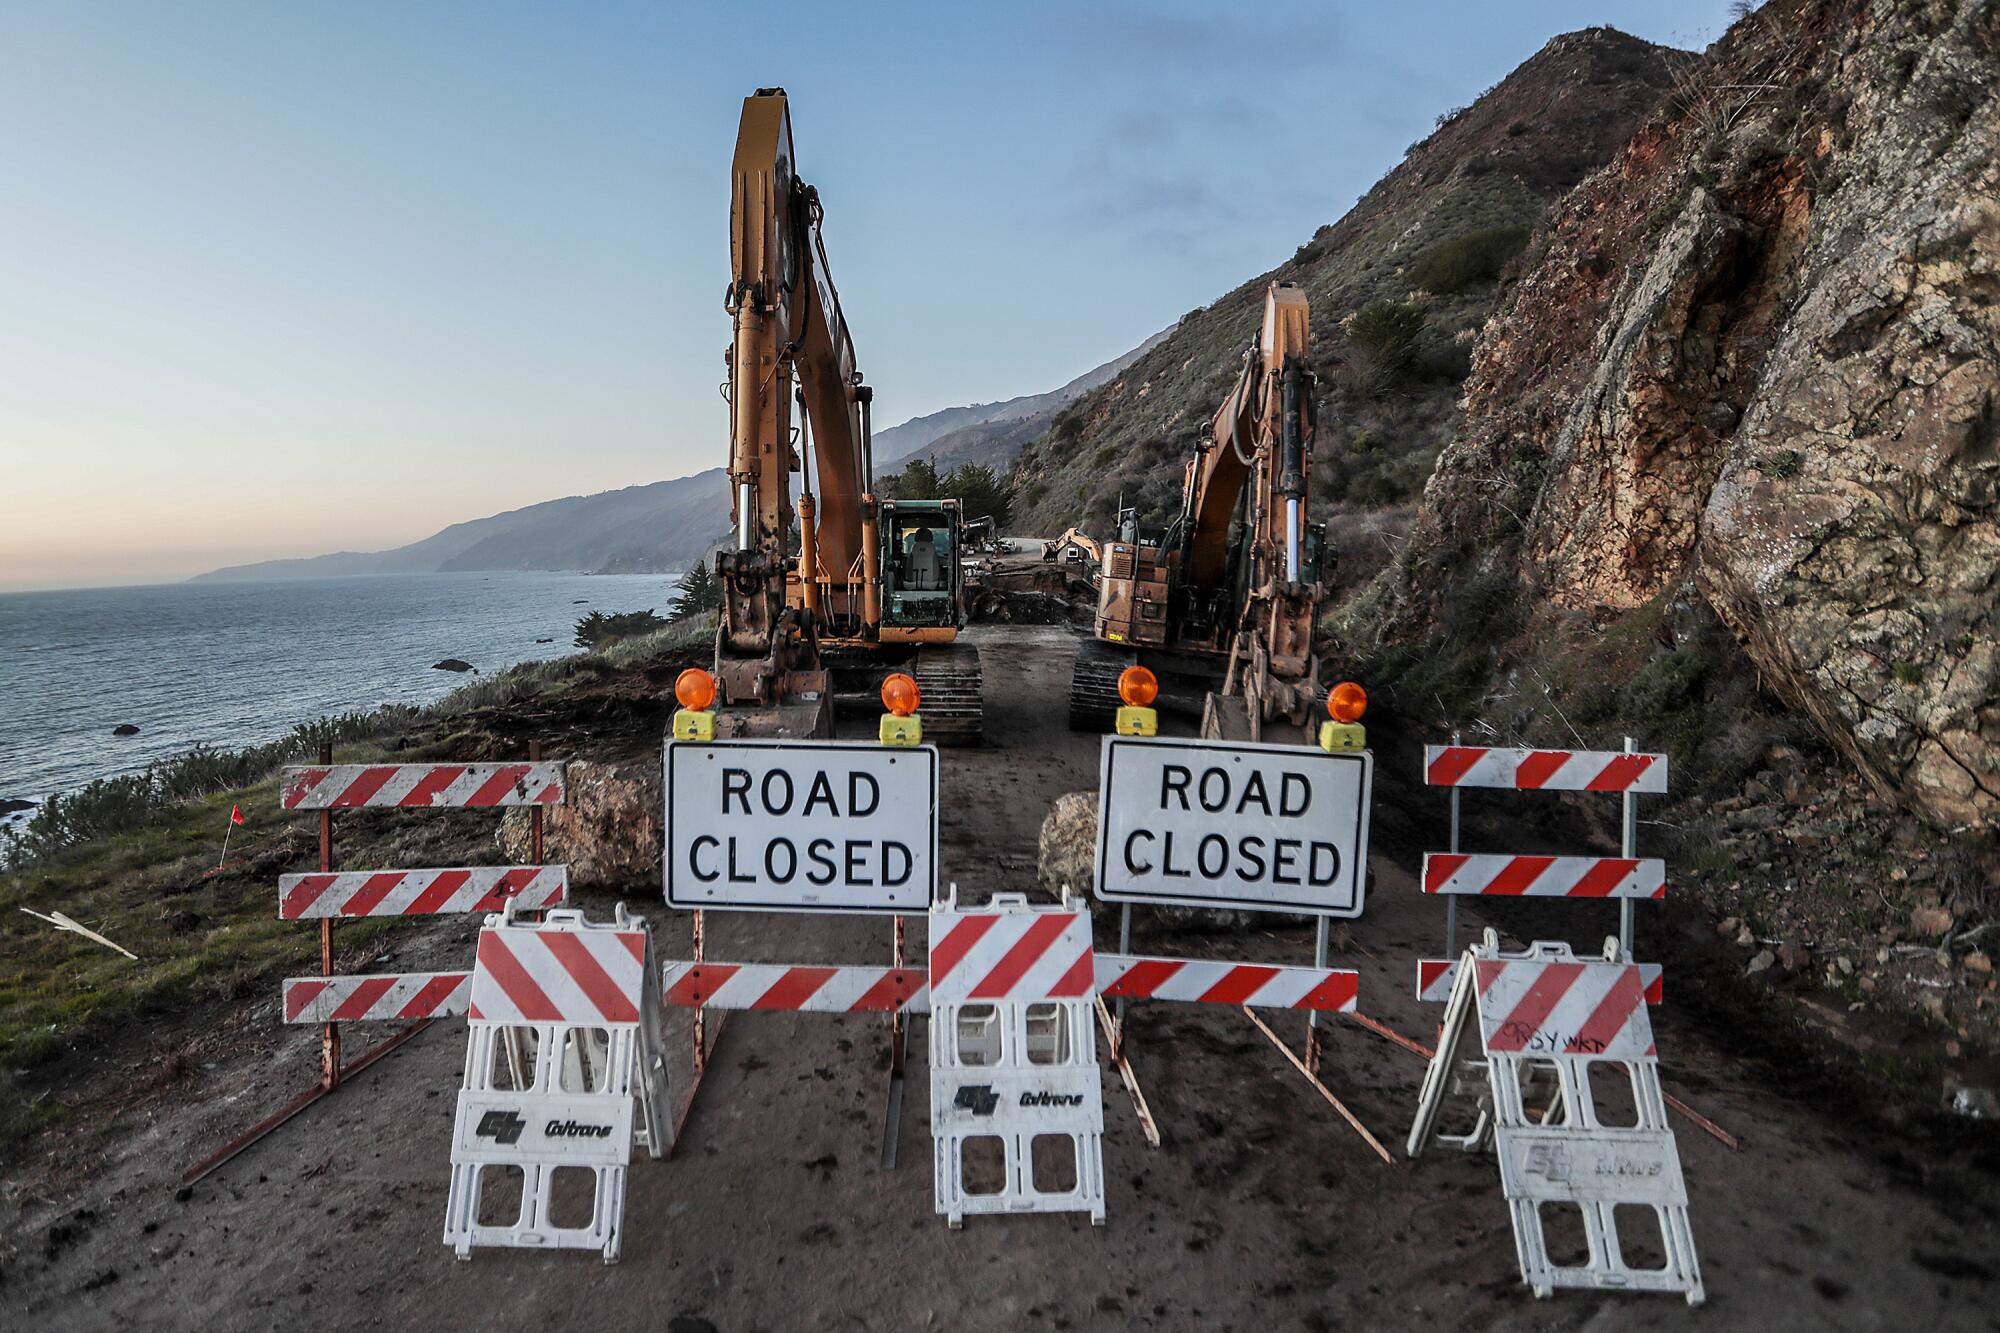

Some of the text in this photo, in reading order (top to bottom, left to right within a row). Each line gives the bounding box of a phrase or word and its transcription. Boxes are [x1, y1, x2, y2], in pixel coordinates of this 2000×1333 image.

[722, 767, 881, 818] ROAD
[1160, 764, 1312, 819] ROAD
[689, 834, 913, 887] CLOSED
[1123, 828, 1341, 887] CLOSED
[544, 1120, 613, 1137] Caltrans
